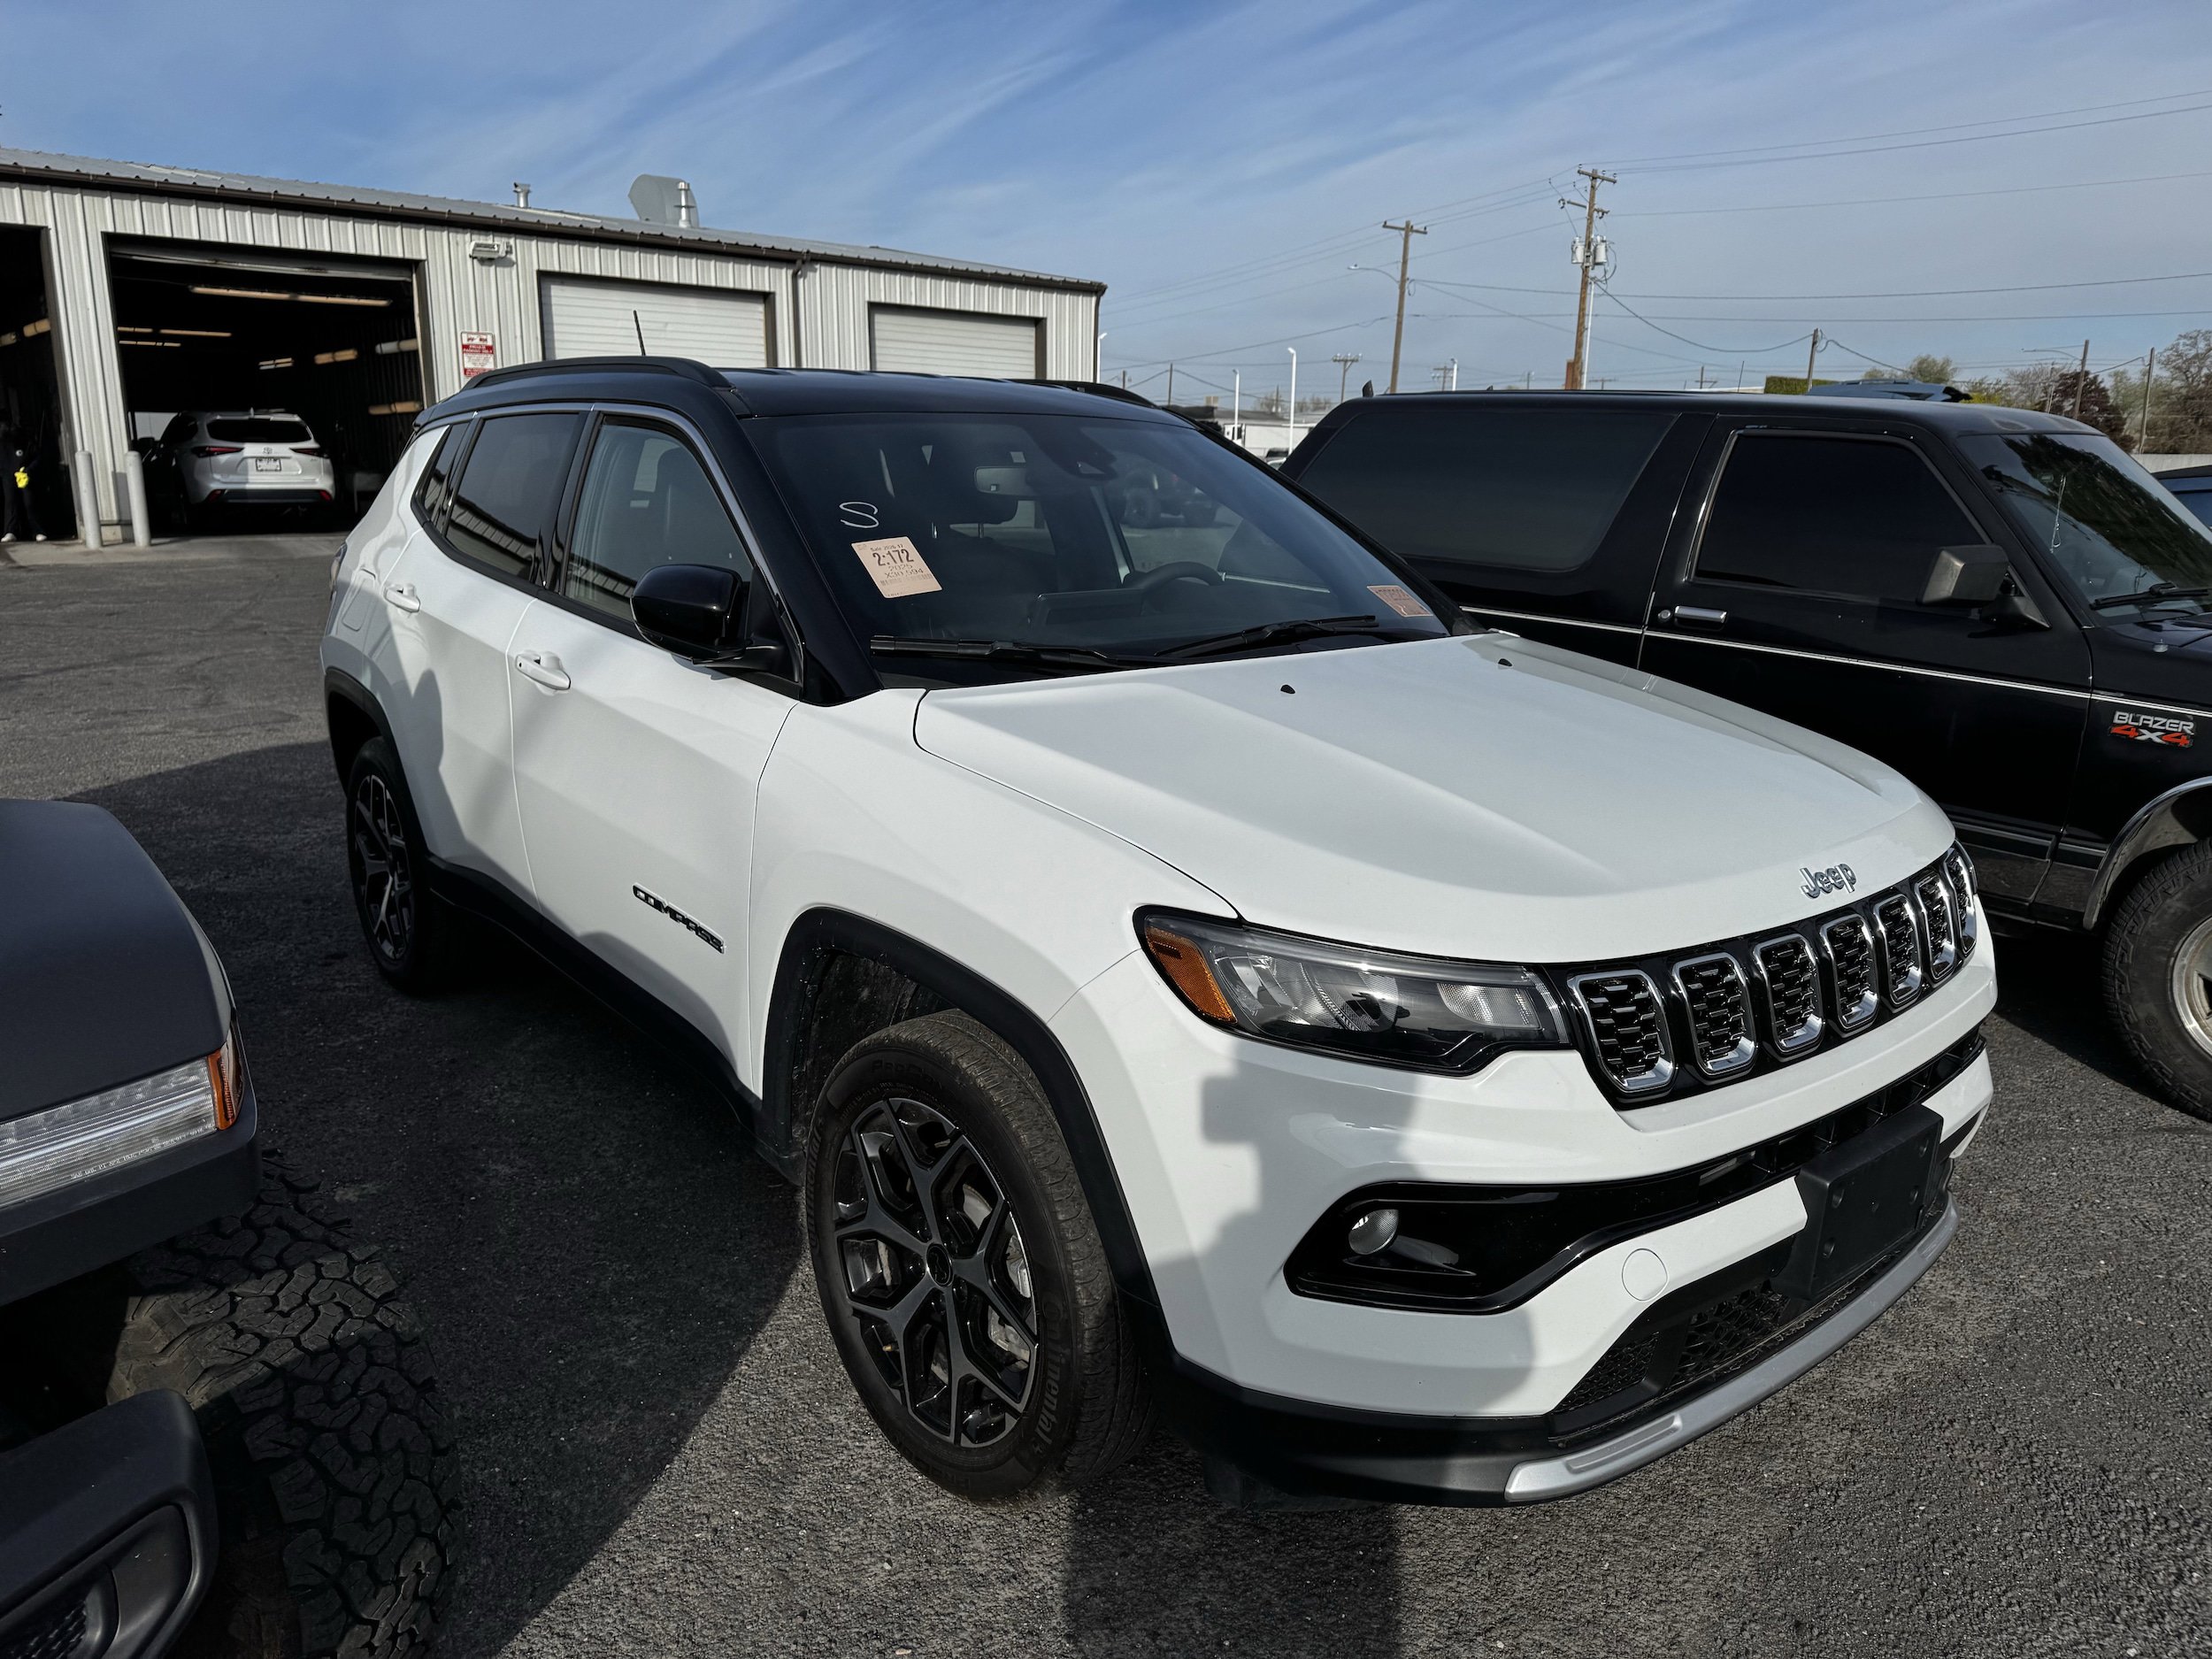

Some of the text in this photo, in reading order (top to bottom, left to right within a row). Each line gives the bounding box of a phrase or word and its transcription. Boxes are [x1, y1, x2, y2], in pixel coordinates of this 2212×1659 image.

[840, 502, 879, 528] S
[872, 549, 914, 566] 2:172
[2113, 710, 2194, 735] BLAZER
[1800, 864, 1856, 899] Jeep
[633, 884, 725, 954] COMPASS
